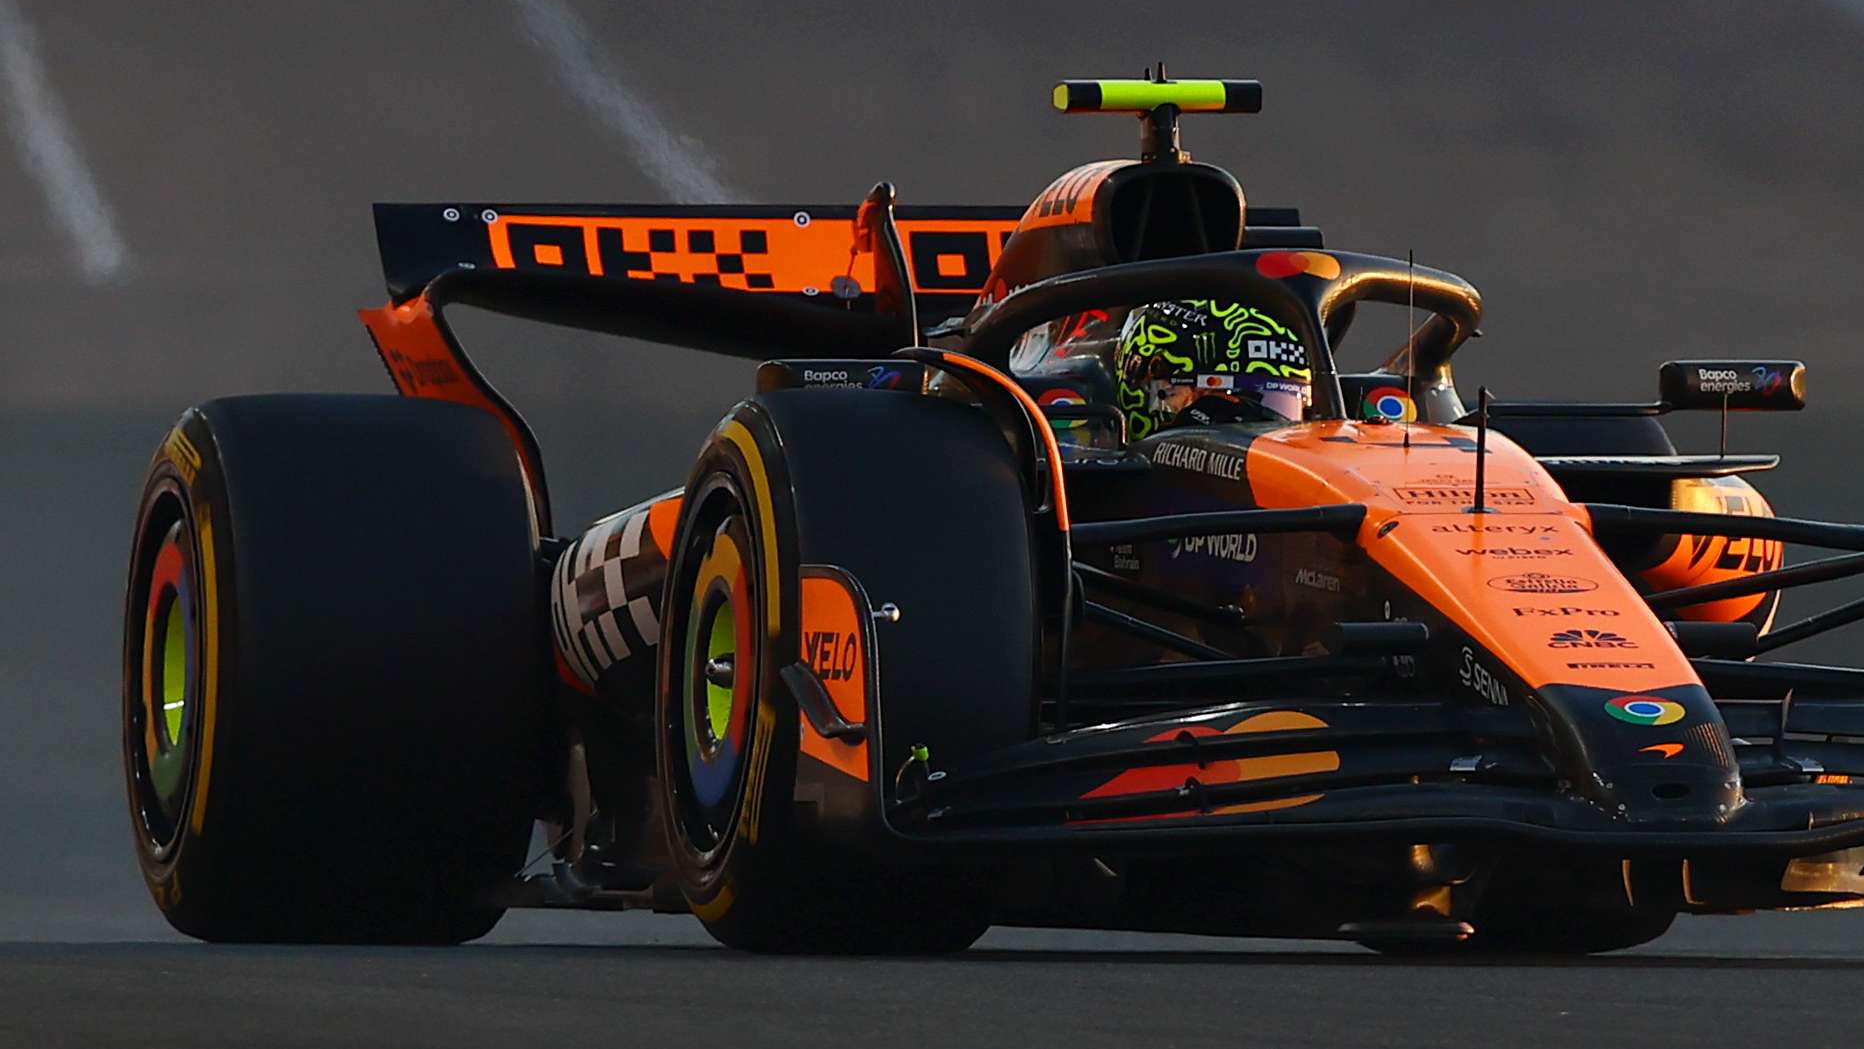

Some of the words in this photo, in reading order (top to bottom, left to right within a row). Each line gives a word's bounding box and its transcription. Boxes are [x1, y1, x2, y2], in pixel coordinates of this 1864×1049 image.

[803, 369, 848, 383] Bapco
[1699, 369, 1737, 382] Bapco
[1700, 380, 1751, 394] energies
[1153, 442, 1207, 472] RICHARD
[1207, 454, 1244, 481] MILLE
[1432, 523, 1560, 534] alteryx
[1207, 533, 1258, 562] WORLD
[1456, 547, 1575, 556] webex
[1295, 568, 1341, 593] McLaren
[1512, 607, 1621, 616] FxPro
[1547, 641, 1639, 649] CNBC
[803, 631, 858, 681] VELO
